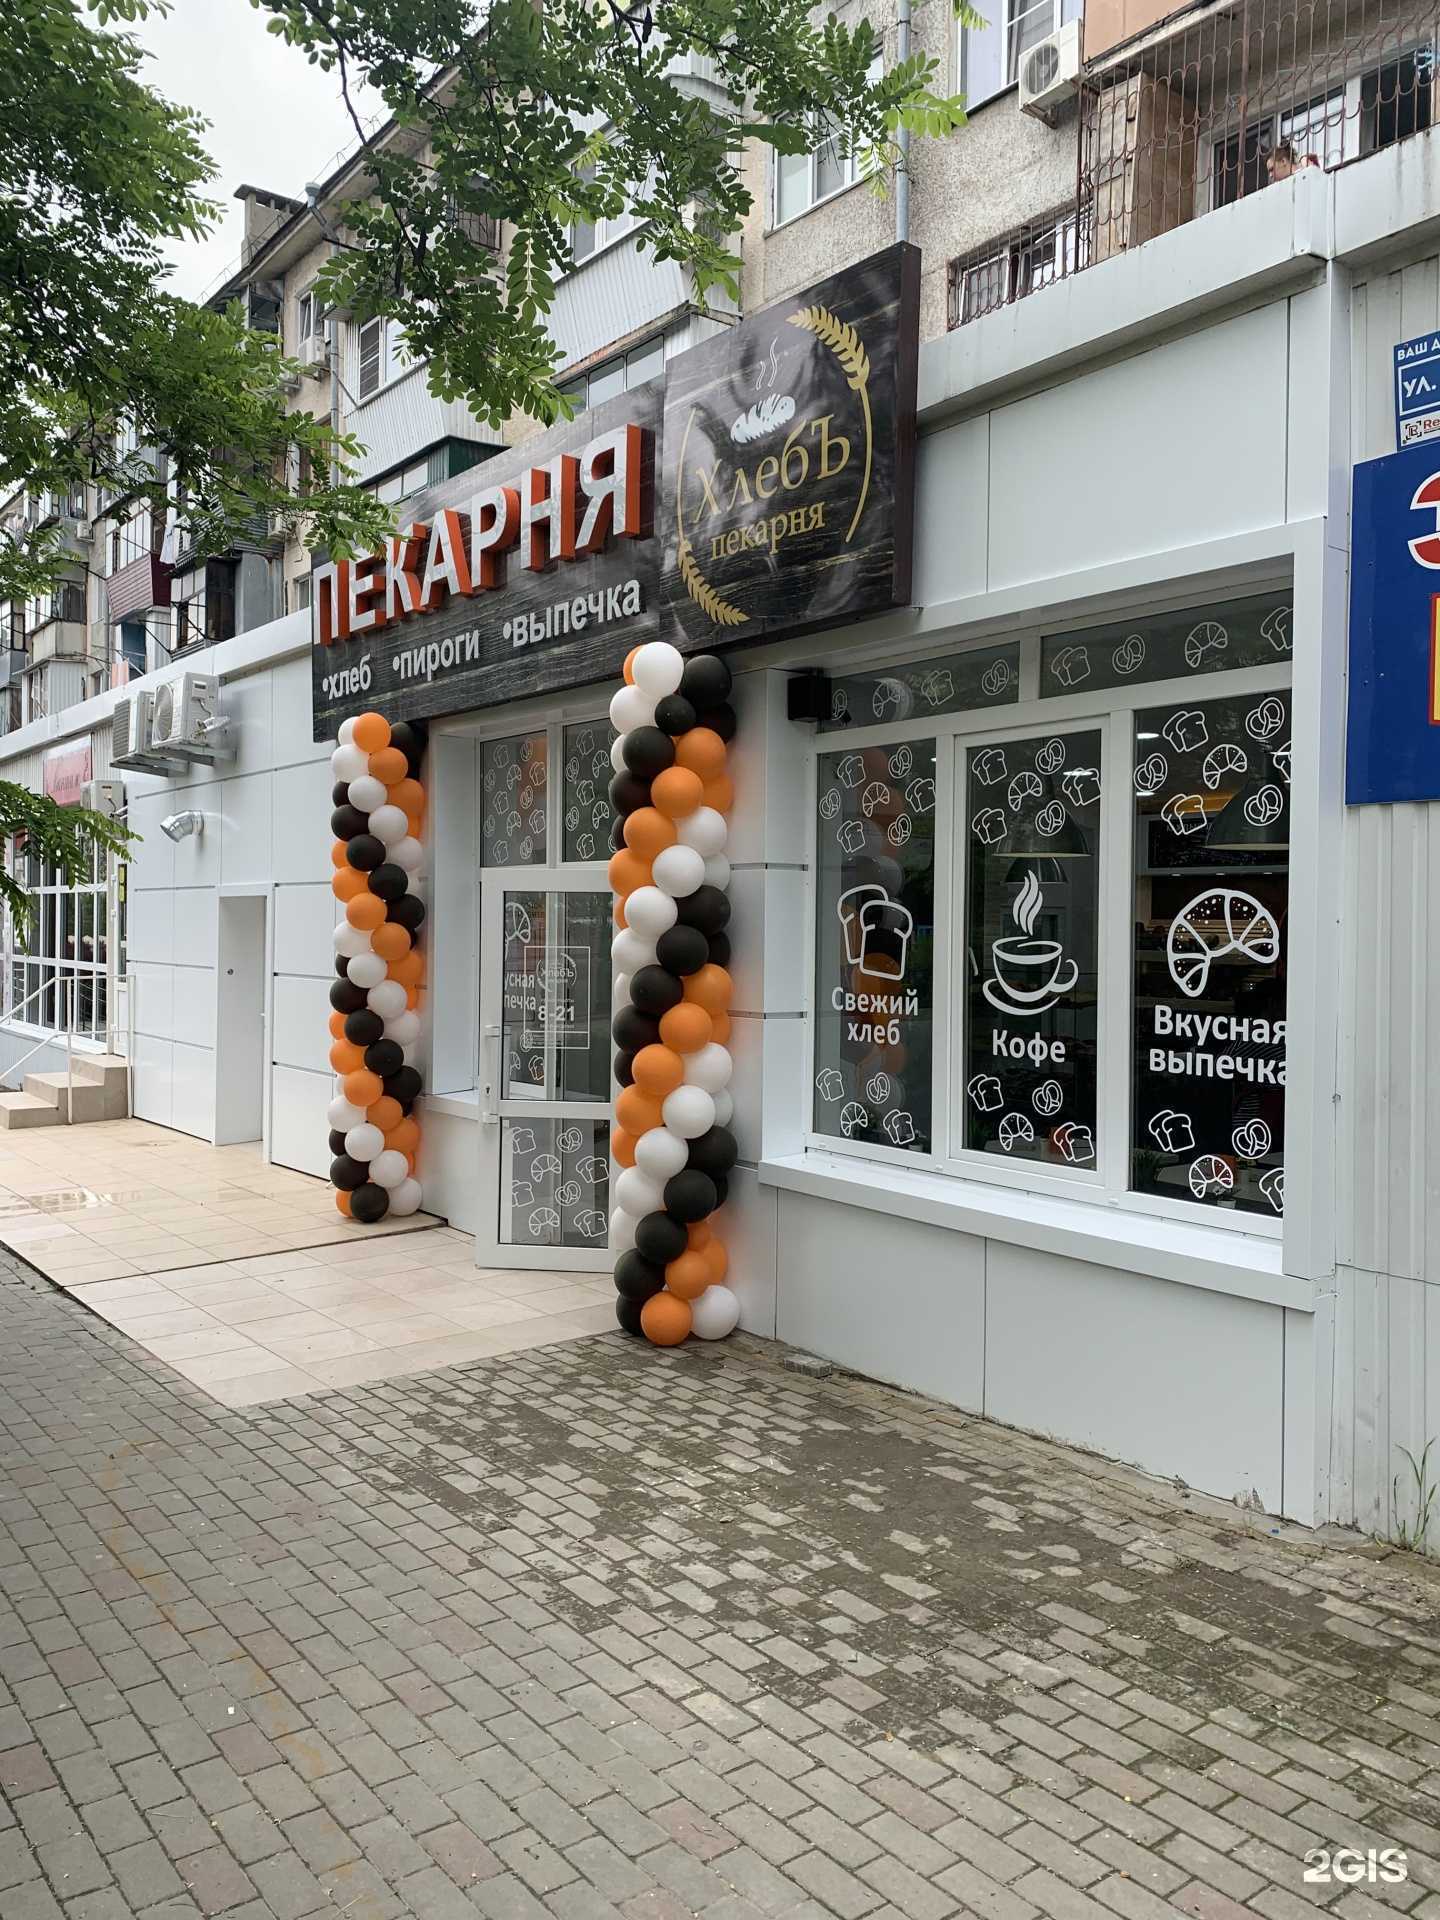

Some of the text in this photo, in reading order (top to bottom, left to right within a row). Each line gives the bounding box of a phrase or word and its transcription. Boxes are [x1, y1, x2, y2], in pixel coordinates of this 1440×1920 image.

[1397, 341, 1428, 361] ВАШ
[690, 415, 850, 524] ХлебЪ
[312, 422, 643, 646] ПЕКАРНЯ
[711, 501, 826, 561] пекарня
[538, 1005, 575, 1022] 8-21
[831, 986, 919, 1016] Свежий
[847, 1019, 901, 1046] хлеб
[1154, 1004, 1288, 1046] Вкусная
[992, 1029, 1066, 1067] Кофе
